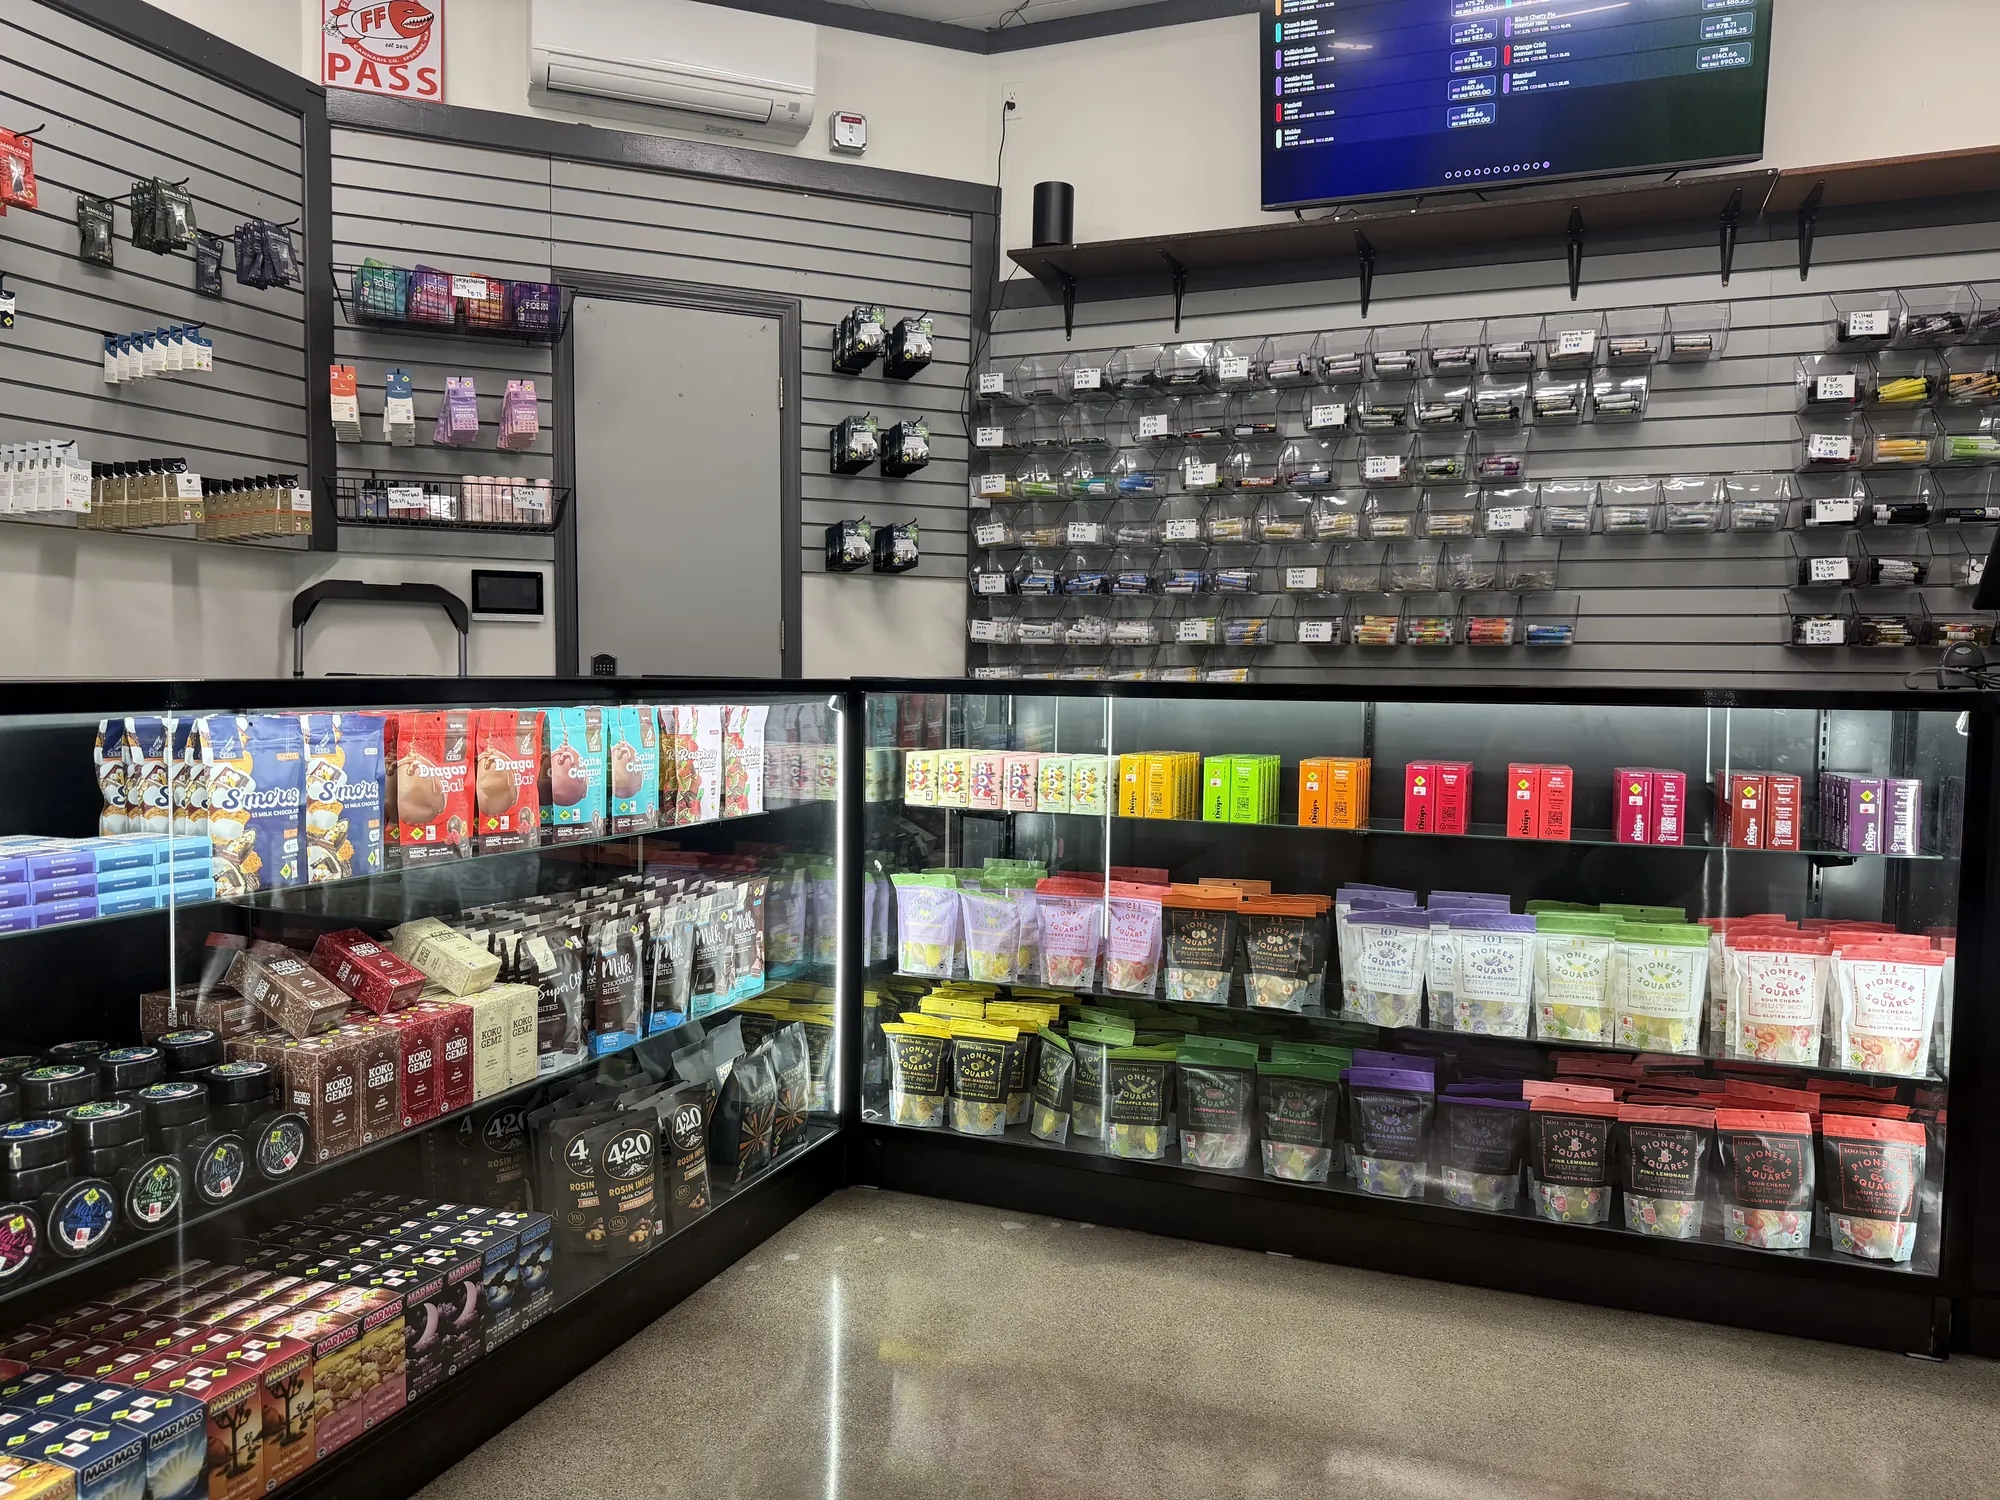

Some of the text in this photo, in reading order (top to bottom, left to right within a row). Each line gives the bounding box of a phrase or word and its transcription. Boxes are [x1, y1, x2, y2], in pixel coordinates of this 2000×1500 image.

[360, 6, 386, 33] FF
[1725, 27, 1747, 35] $86.25
[353, 45, 387, 63] CANNABIS
[1711, 51, 1738, 60] $140.66
[1720, 57, 1745, 65] $90.00
[328, 52, 438, 95] PASS
[70, 472, 89, 482] ratio
[418, 764, 467, 778] Dragon
[222, 787, 299, 811] S'mores
[1309, 799, 1319, 824] Drops
[1417, 804, 1426, 830] Drops
[1520, 809, 1530, 835] Drops
[1632, 813, 1643, 841] Drops
[1744, 816, 1756, 845] Drops
[1864, 821, 1875, 851] Drops
[736, 912, 755, 930] Milk
[1117, 914, 1150, 928] PIONEER
[1181, 920, 1218, 934] PIONEER
[696, 926, 723, 945] Milk
[1257, 926, 1295, 940] PIONEER
[1482, 935, 1503, 944] 10:1
[1181, 935, 1218, 947] SQUARES
[1256, 940, 1294, 953] SQUARES
[659, 940, 684, 961] Milk
[1471, 947, 1514, 962] PIONEER
[1555, 951, 1600, 965] PIONEER
[602, 954, 633, 979] Milk
[1367, 953, 1406, 968] SQUARES
[1470, 961, 1514, 975] SQUARES
[1555, 966, 1600, 979] SQUARES
[1637, 961, 1683, 977] PIONEER
[1759, 967, 1806, 983] PIONEER
[602, 975, 634, 989] CHOCOLATE
[1636, 976, 1683, 991] SQUARES
[1865, 978, 1916, 992] PIONEER
[538, 982, 569, 1002] Super
[603, 986, 620, 995] BITES
[1759, 983, 1806, 998] SQUARES
[538, 1004, 559, 1012] BITES
[1865, 993, 1916, 1009] SQUARES
[1640, 1005, 1680, 1013] GLUTEN-FREE
[513, 1016, 533, 1029] KOKO
[1869, 1024, 1911, 1032] GLUTEN-FREE
[481, 1026, 503, 1040] KOKO
[512, 1024, 533, 1038] GEMZ
[445, 1037, 468, 1052] KOKO
[481, 1035, 503, 1049] GEMZ
[408, 1049, 432, 1064] KOKO
[445, 1047, 468, 1061] GEMZ
[961, 1052, 996, 1067] PIONEER
[368, 1063, 394, 1078] KOKO
[407, 1060, 432, 1074] GEMZ
[960, 1065, 995, 1079] SQUARES
[325, 1076, 353, 1091] KOKO
[368, 1073, 395, 1089] GEMZ
[325, 1087, 353, 1103] GEMZ
[1196, 1082, 1235, 1096] PIONEER
[1371, 1103, 1412, 1120] PIONEER
[676, 1107, 702, 1135] 420
[1370, 1119, 1412, 1134] SQUARES
[1387, 1134, 1417, 1142] BLUEBERRY
[1552, 1128, 1597, 1145] PIONEER
[607, 1134, 651, 1164] 420
[1552, 1144, 1598, 1160] SQUARES
[1640, 1139, 1689, 1157] PIONEER
[1565, 1159, 1599, 1167] LEMONADE
[1641, 1155, 1690, 1171] SQUARES
[1744, 1150, 1792, 1167] PIONEER
[1655, 1170, 1690, 1180] LEMONADE
[1744, 1166, 1793, 1182] SQUARES
[141, 1177, 174, 1194] Mari's
[569, 1180, 595, 1191] ROSIN
[1767, 1181, 1791, 1189] CHERRY
[1852, 1175, 1903, 1191] SQUARES
[609, 1185, 632, 1197] ROSIN
[1644, 1187, 1685, 1195] GLUTEN-FREE
[1749, 1197, 1790, 1206] GLUTEN-FREE
[364, 1301, 402, 1330] MARMAS
[317, 1325, 358, 1355] MARMAS
[266, 1349, 311, 1382] MARMAS
[209, 1378, 259, 1412] MARMAS
[150, 1410, 203, 1447] MARMAS
[85, 1443, 143, 1482] MARMAS
